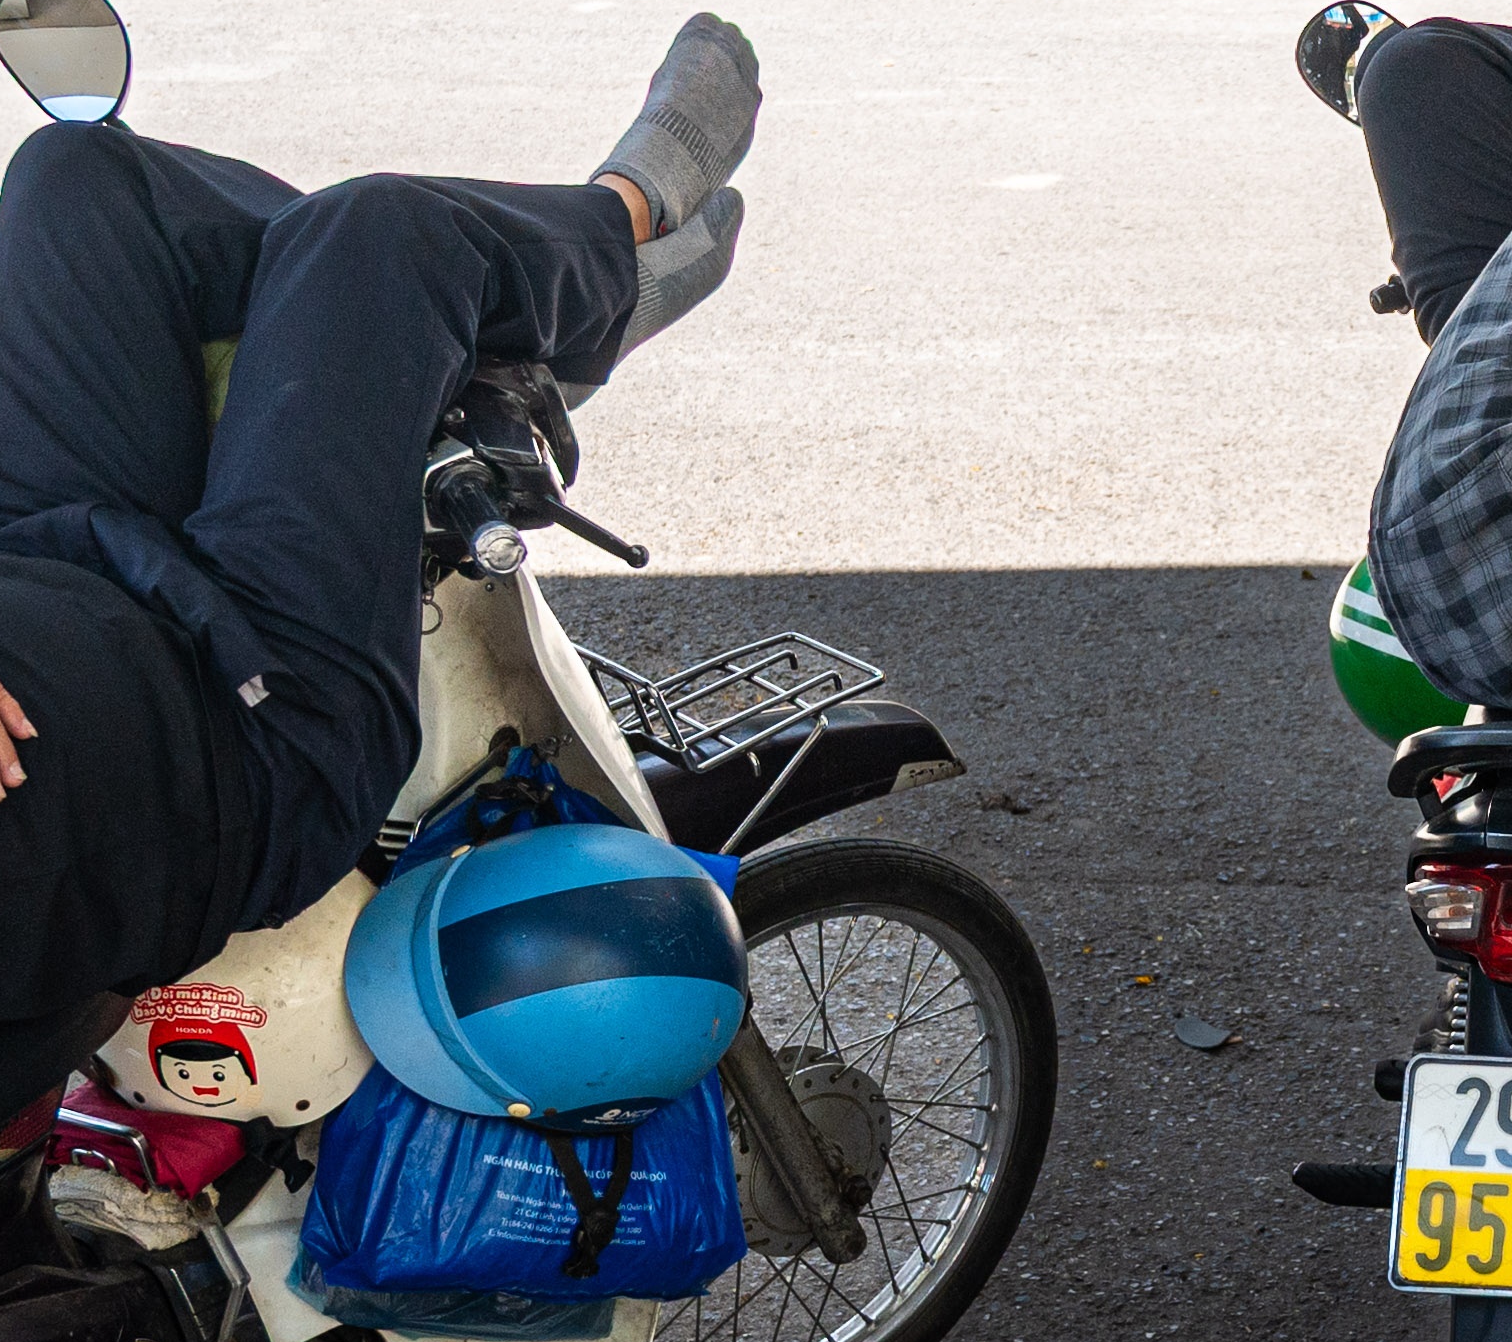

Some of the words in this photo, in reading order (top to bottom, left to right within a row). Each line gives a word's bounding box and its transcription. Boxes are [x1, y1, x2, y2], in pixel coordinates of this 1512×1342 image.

[175, 1026, 213, 1035] HONDA
[483, 1153, 512, 1169] NGÂN
[513, 1157, 544, 1176] HÀNG
